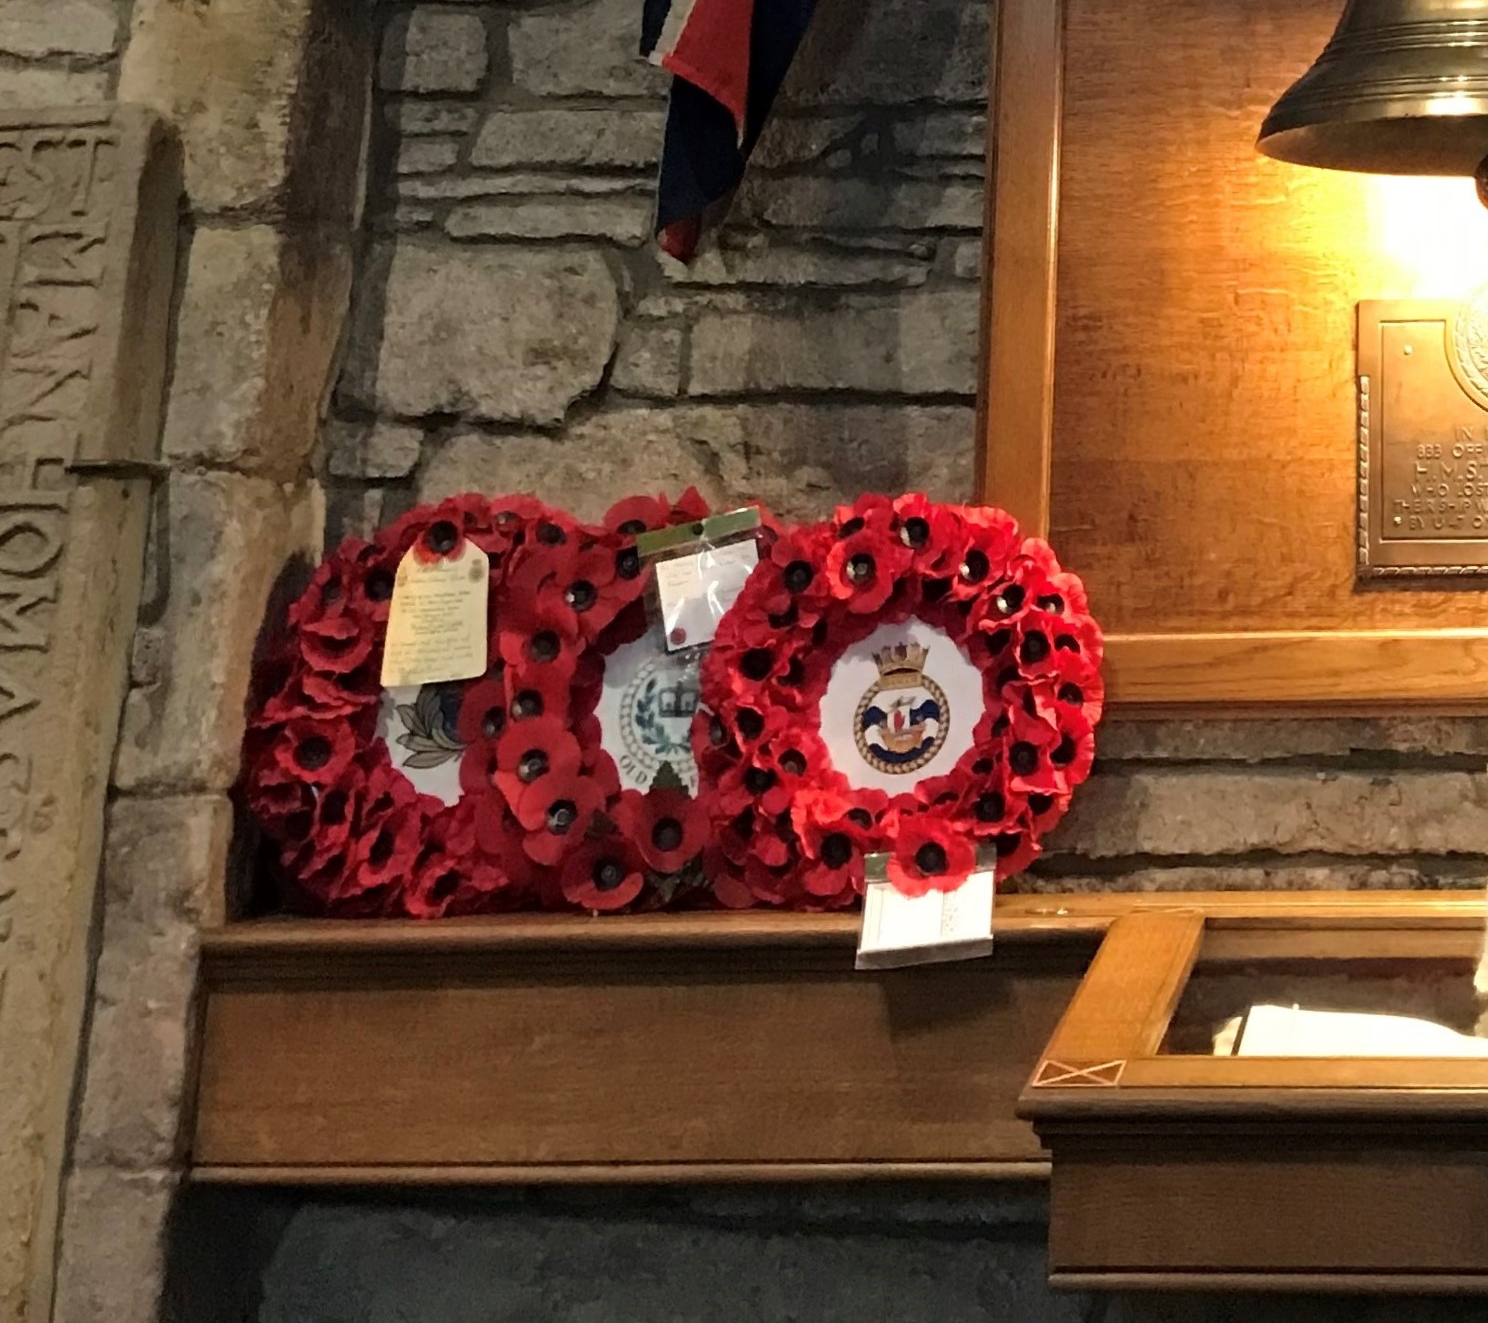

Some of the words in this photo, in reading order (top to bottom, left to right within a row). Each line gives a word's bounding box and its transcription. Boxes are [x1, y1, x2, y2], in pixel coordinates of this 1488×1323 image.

[1454, 426, 1474, 441] IN
[1416, 443, 1442, 459] 833
[1410, 482, 1449, 497] WHO
[1392, 498, 1434, 514] THEIR
[1438, 498, 1472, 514] SHIP
[1409, 514, 1424, 530] BY
[619, 754, 648, 784] OLD
